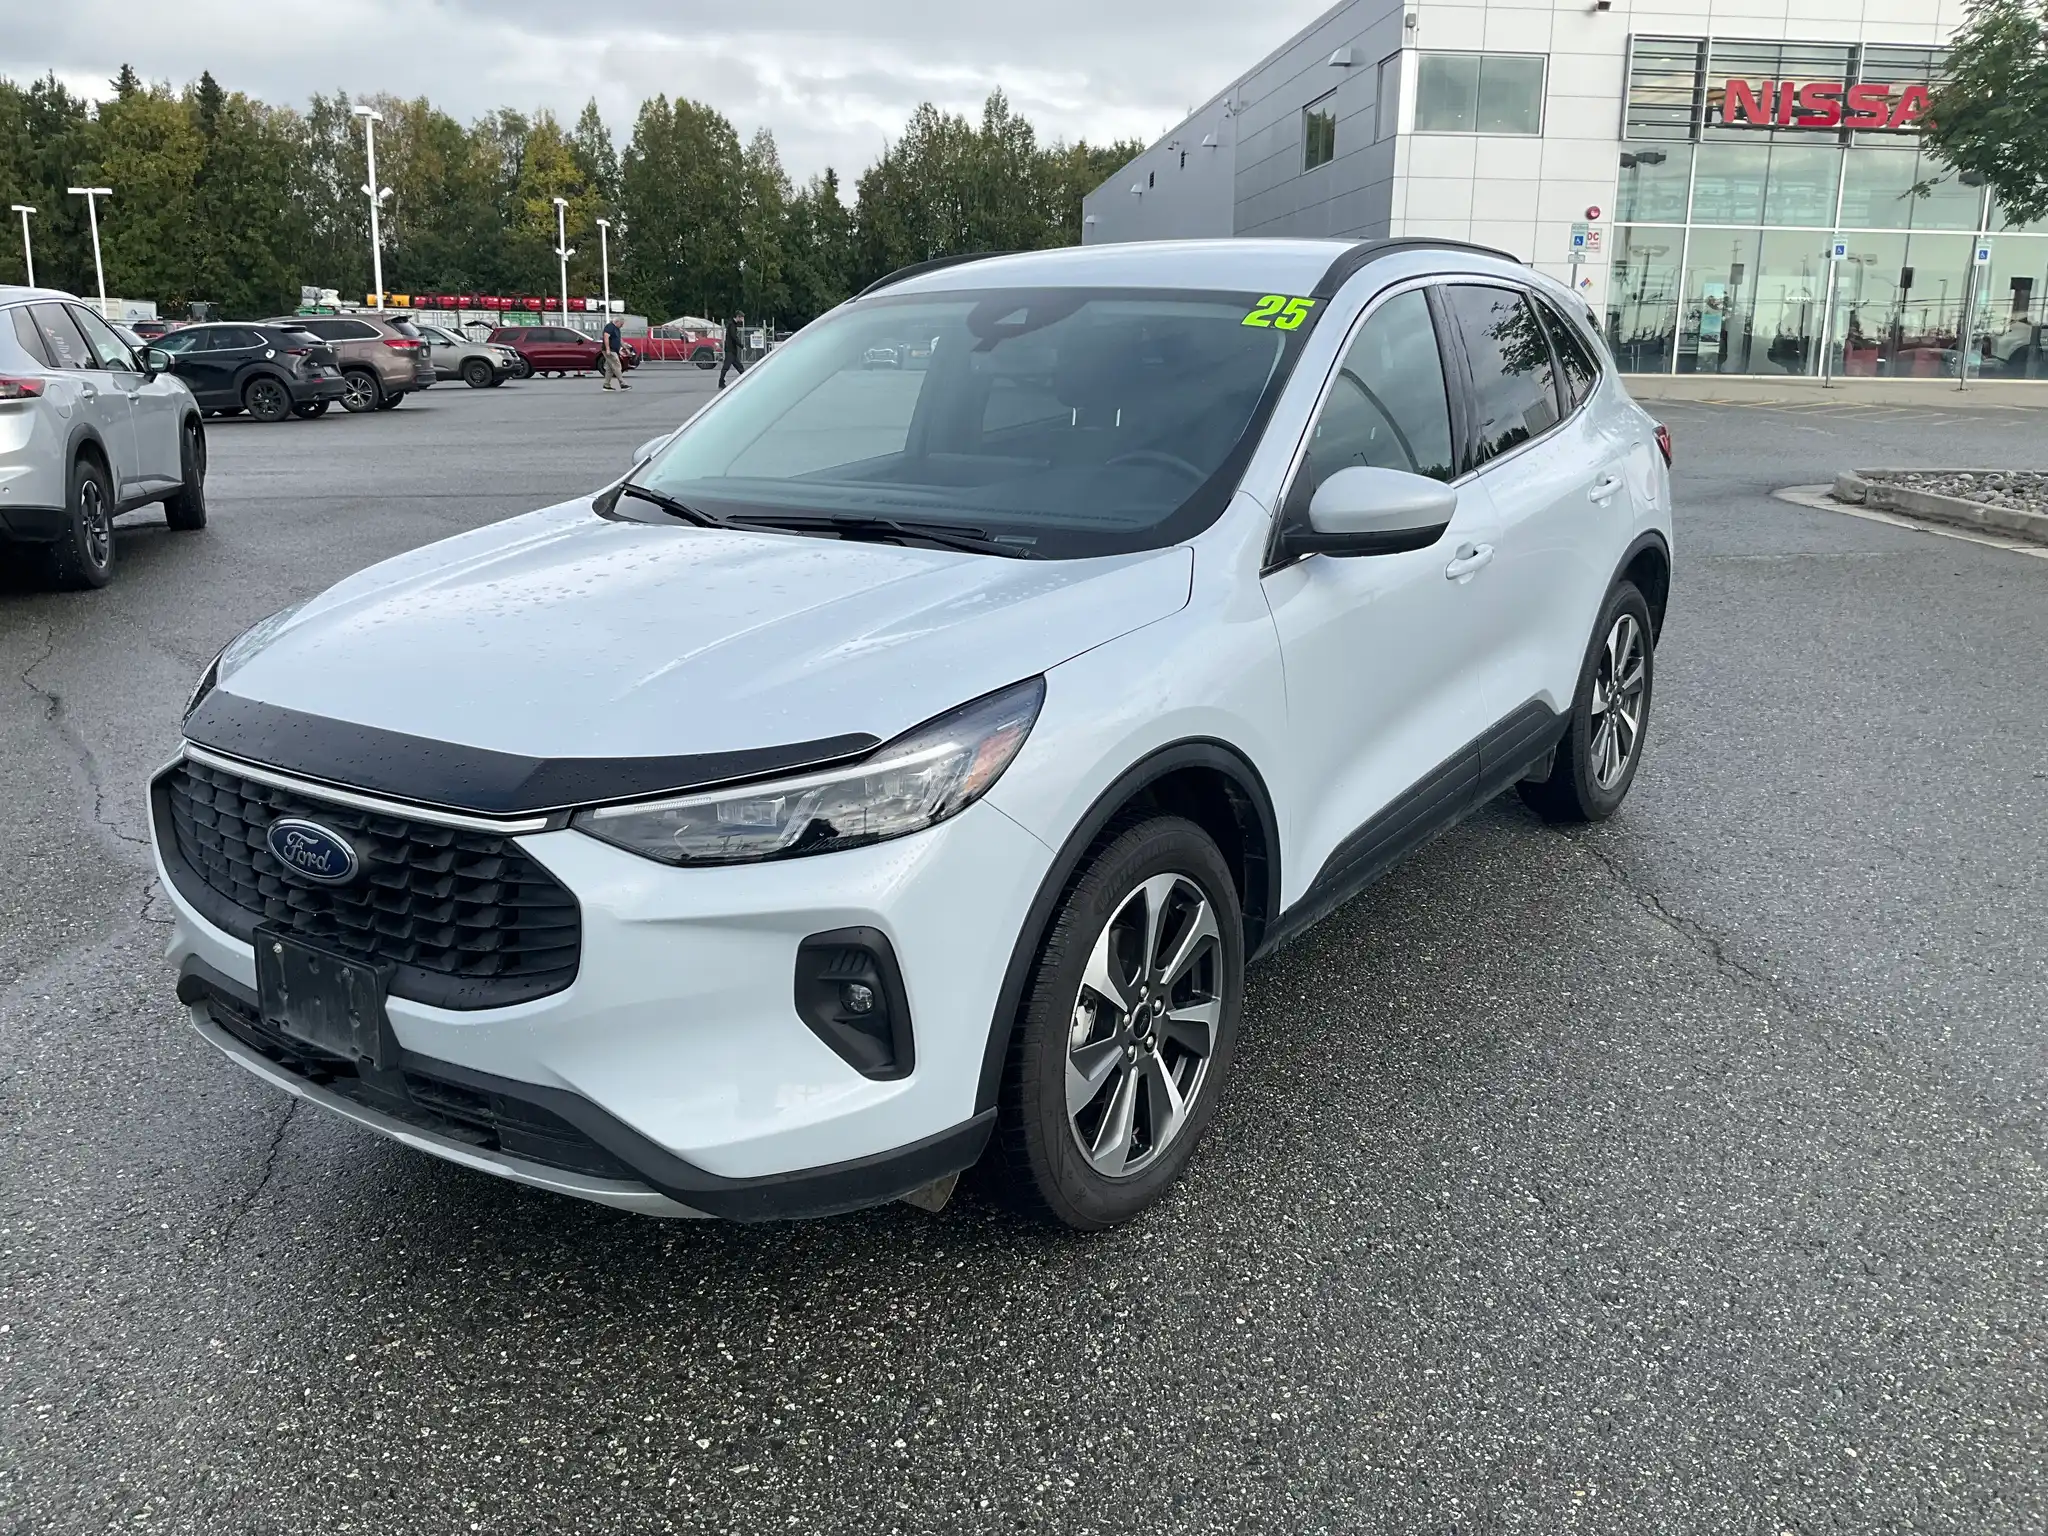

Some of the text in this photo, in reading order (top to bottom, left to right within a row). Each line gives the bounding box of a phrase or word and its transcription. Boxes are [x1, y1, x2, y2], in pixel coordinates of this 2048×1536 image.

[1722, 79, 1937, 129] NISSA
[1241, 294, 1316, 330] 25
[283, 831, 332, 871] Ford
